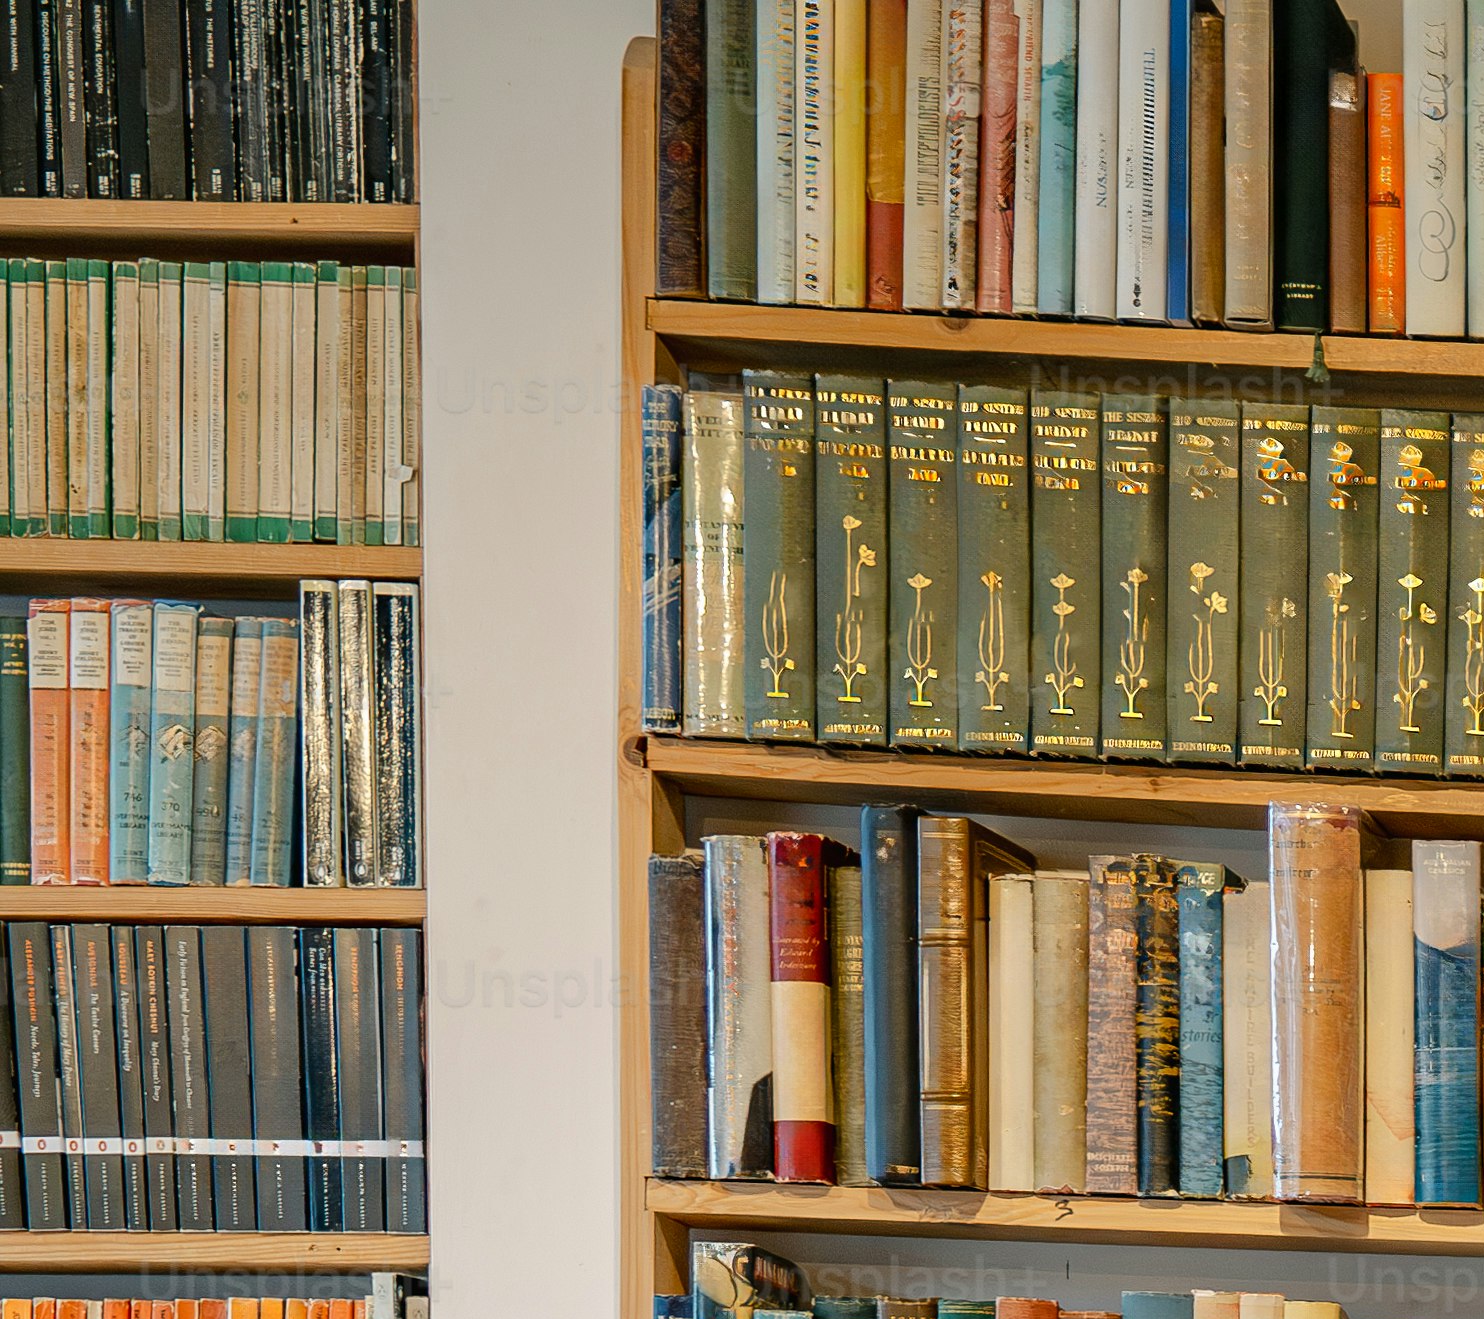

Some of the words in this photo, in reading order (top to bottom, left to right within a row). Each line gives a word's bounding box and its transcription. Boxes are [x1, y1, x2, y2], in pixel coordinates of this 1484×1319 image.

[67, 14, 76, 28] THE
[124, 791, 143, 802] 746
[162, 802, 181, 812] 370
[1182, 1029, 1223, 1044] stories
